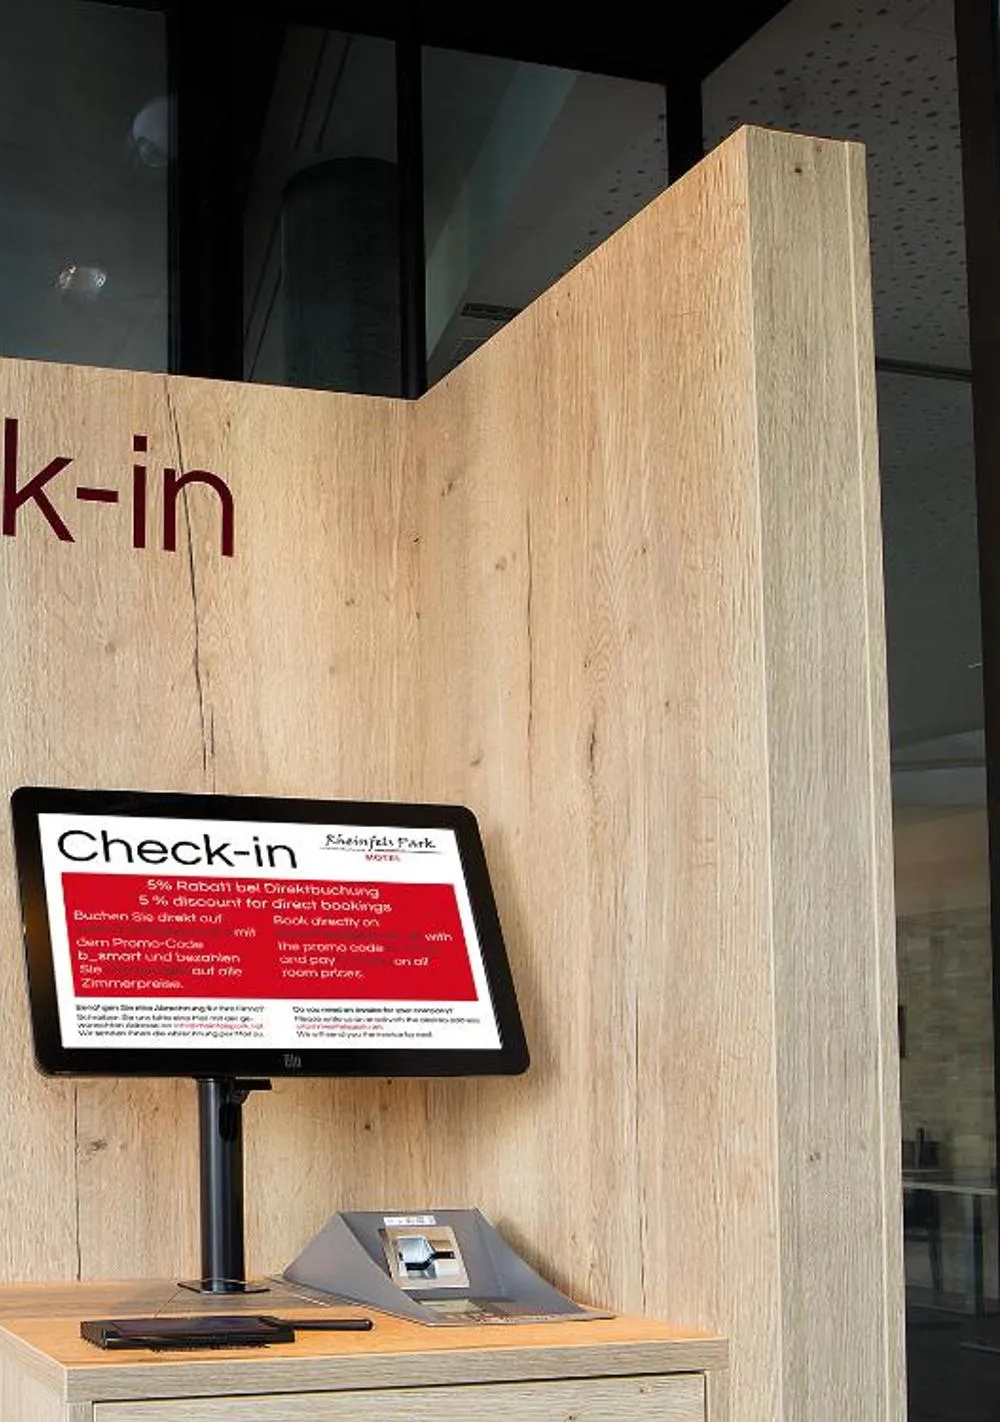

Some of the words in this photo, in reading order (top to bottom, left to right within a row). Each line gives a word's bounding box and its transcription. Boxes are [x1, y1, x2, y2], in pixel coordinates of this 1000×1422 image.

[326, 834, 394, 850] Rheinfels
[398, 837, 436, 849] Park
[58, 830, 298, 869] Check-in
[147, 879, 172, 891] 5%
[177, 880, 231, 892] Rabatt
[236, 882, 259, 893] bei
[264, 883, 379, 899] Direktbuchung
[139, 894, 149, 905] 5
[152, 895, 168, 906] %
[173, 896, 241, 907] discount
[247, 898, 267, 909] for
[272, 899, 317, 910] direct
[321, 901, 392, 914] bookings
[73, 910, 128, 921] Buchen
[132, 912, 154, 922] Sie
[158, 913, 197, 922] direkt
[200, 914, 222, 923] auf
[273, 915, 307, 925] Book
[234, 928, 256, 937] mit
[112, 938, 203, 949] Promo-Code
[145, 952, 173, 962] und
